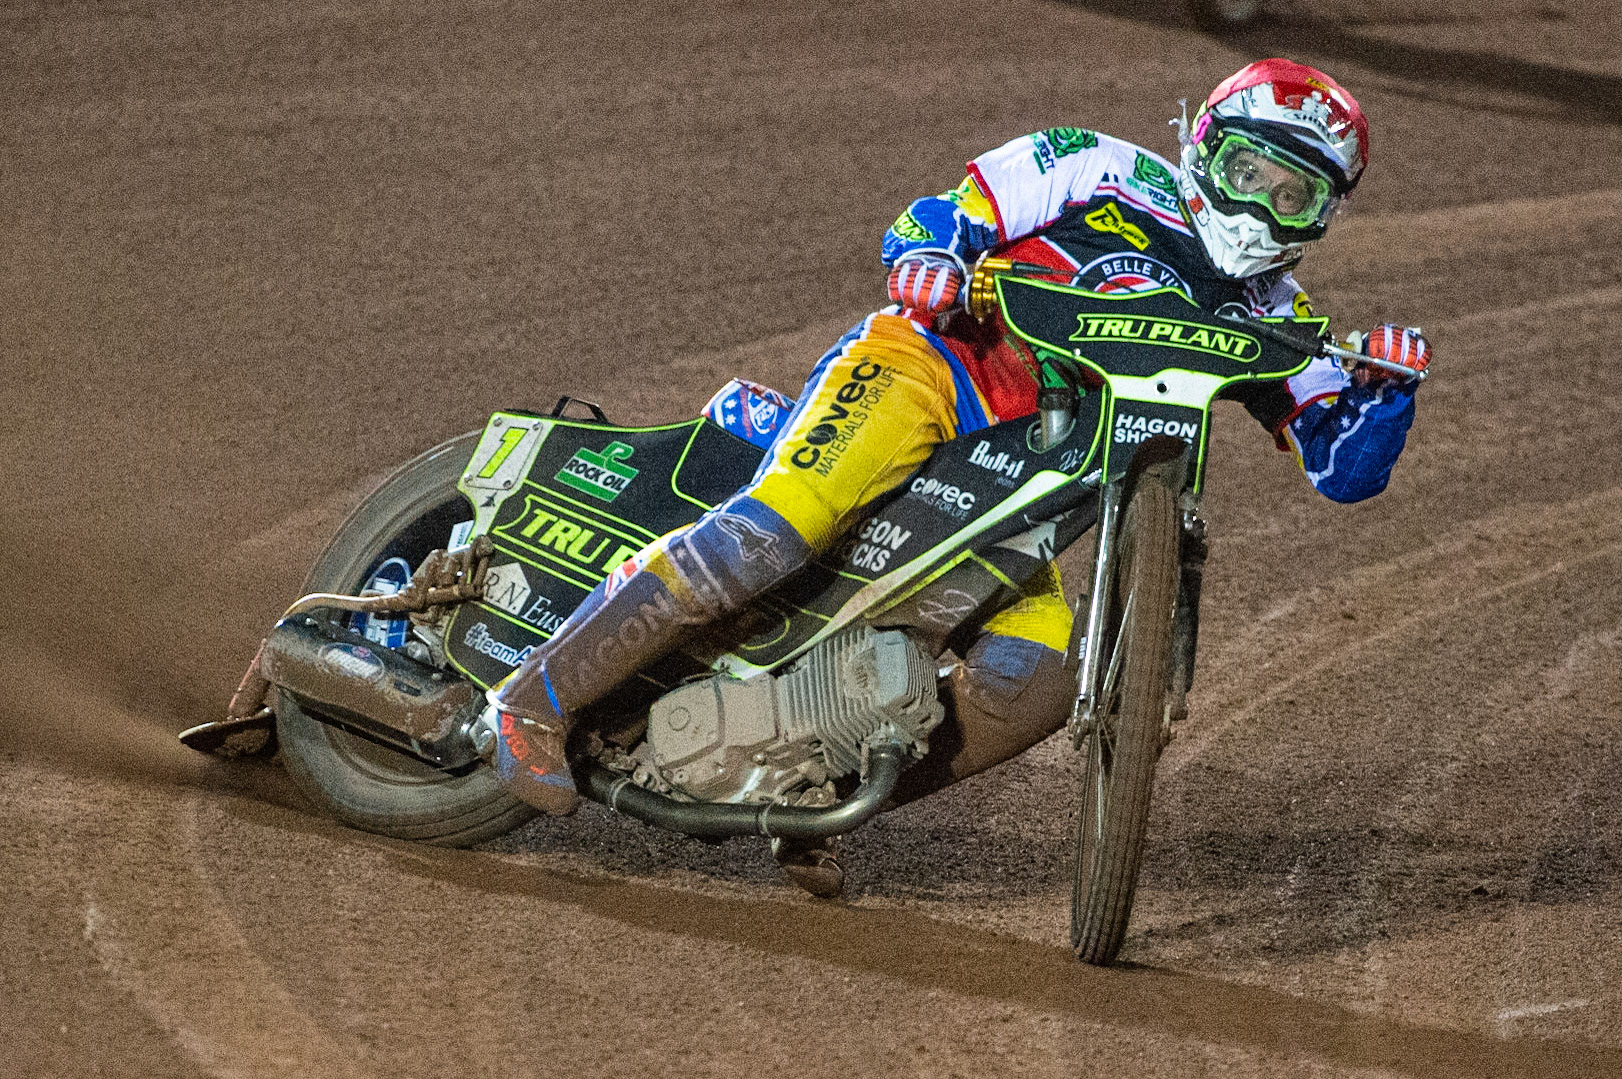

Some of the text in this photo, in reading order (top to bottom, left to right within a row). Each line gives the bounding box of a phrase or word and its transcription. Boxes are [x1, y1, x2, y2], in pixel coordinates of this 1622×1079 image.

[1101, 260, 1153, 276] BELLE
[1086, 319, 1251, 356] TRU PLANT
[814, 410, 868, 478] MATERIALS
[859, 384, 887, 411] FOR
[1115, 414, 1198, 439] HAGON
[477, 427, 530, 479] 1
[565, 458, 628, 493] ROCK OIL
[520, 508, 610, 564] TRU
